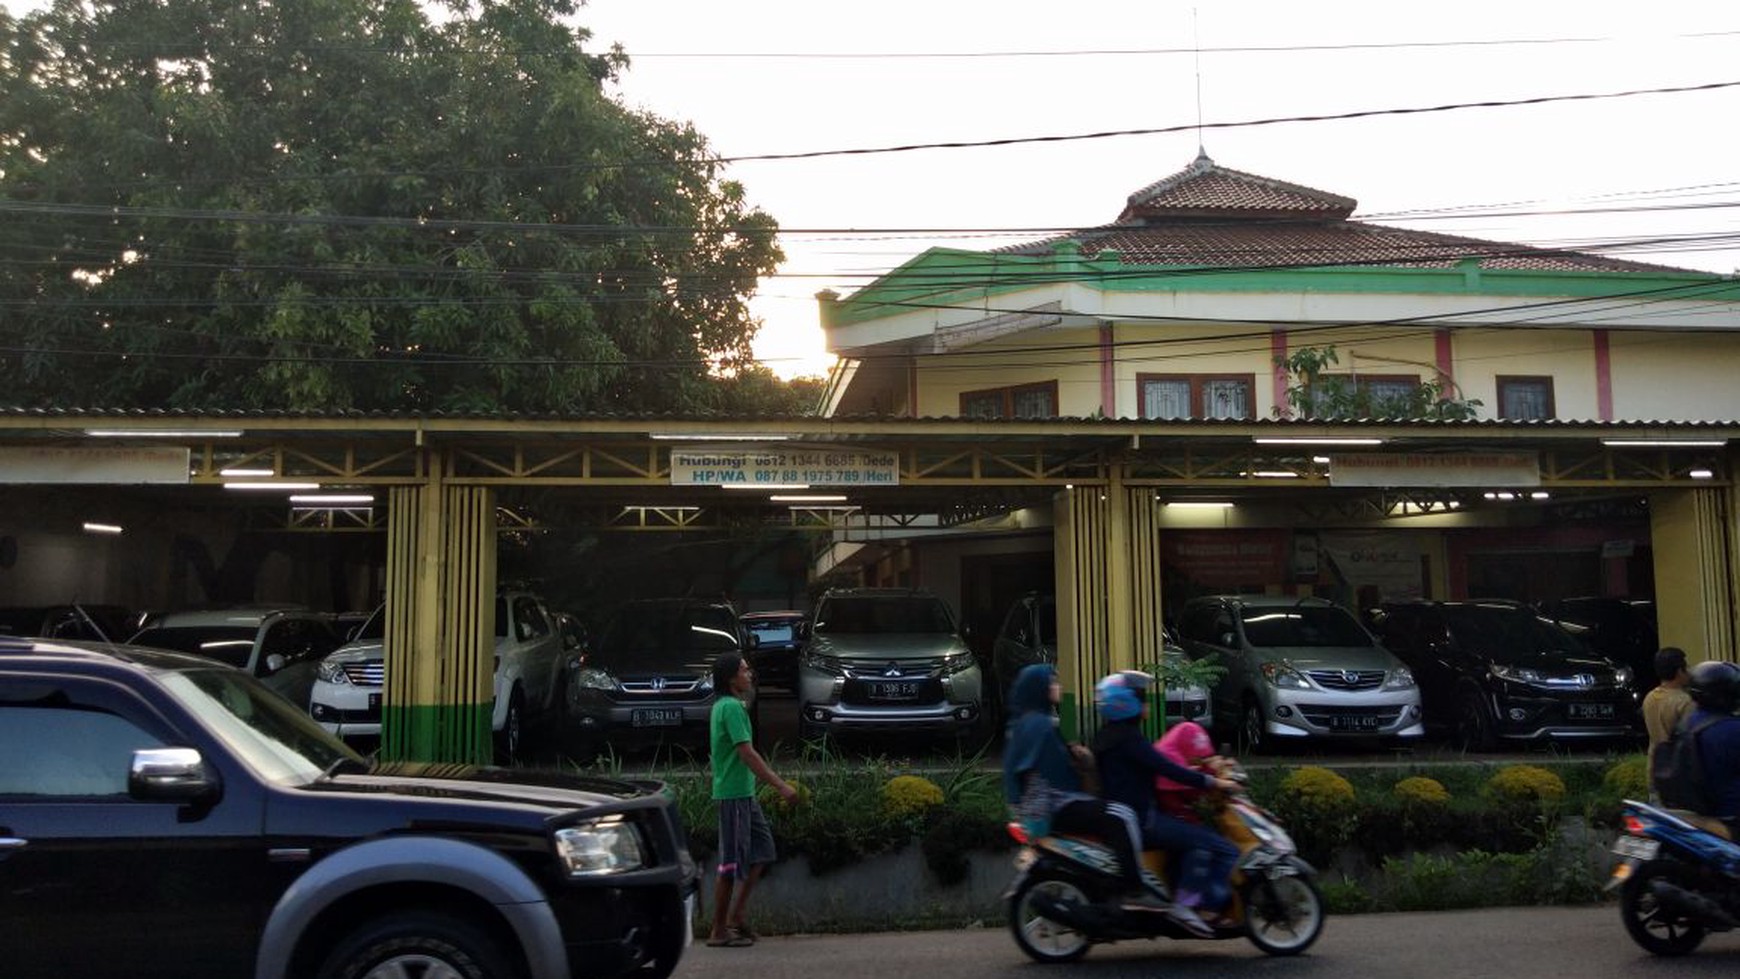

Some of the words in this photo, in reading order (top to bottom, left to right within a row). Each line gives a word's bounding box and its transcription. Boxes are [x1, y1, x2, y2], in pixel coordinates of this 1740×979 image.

[693, 470, 746, 483] HP/WA
[755, 470, 778, 483] 087
[803, 470, 833, 483] 1975
[836, 470, 860, 483] 789
